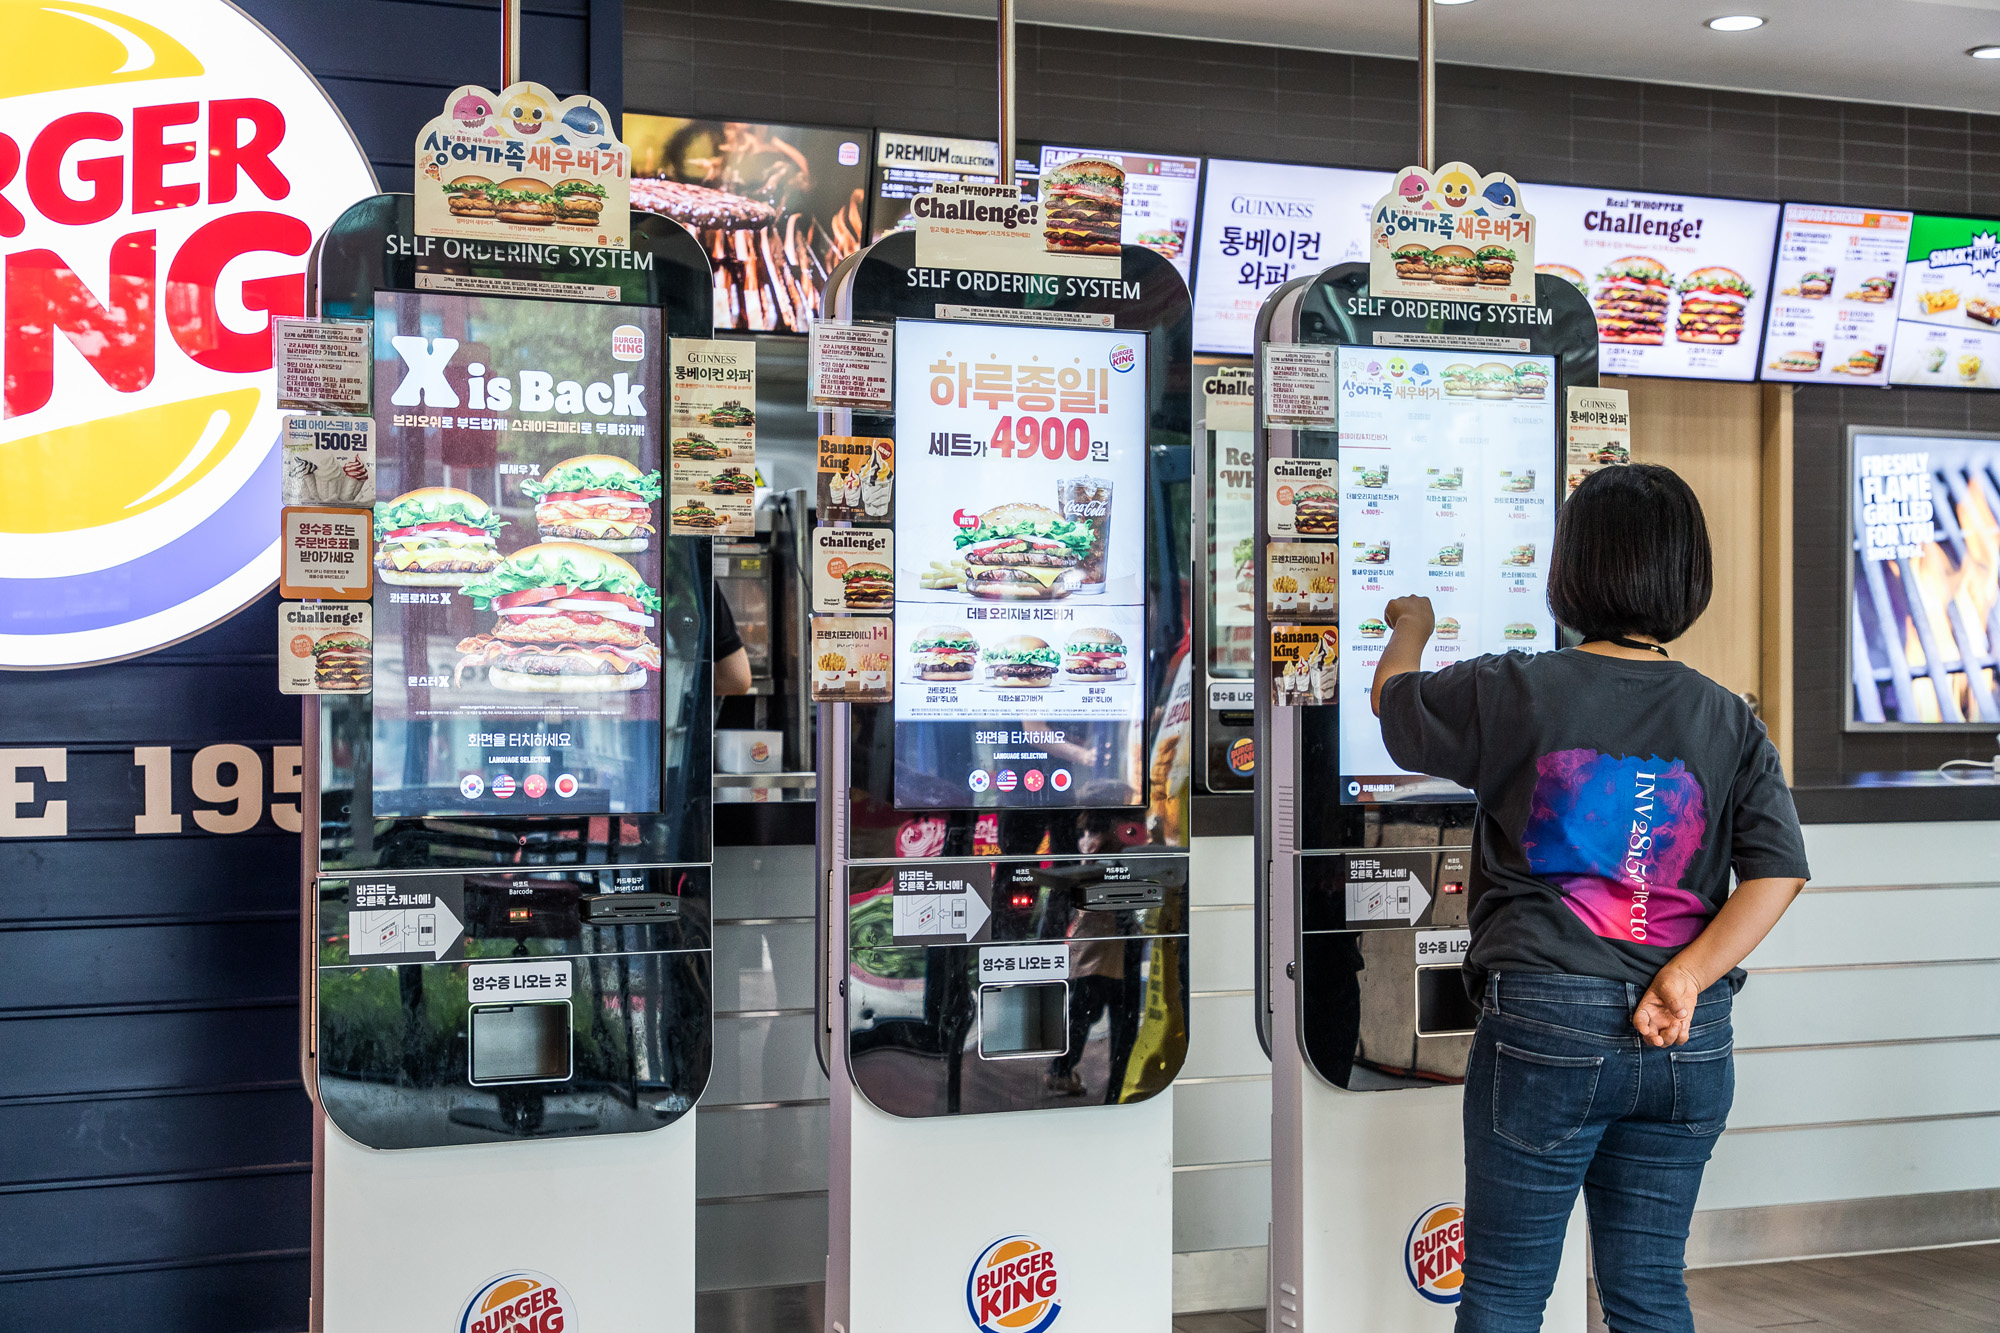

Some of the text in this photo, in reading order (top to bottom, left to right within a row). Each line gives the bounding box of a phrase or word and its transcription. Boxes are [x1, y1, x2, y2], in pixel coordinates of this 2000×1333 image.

[424, 131, 622, 177] 상어가족 새우버거
[886, 143, 994, 166] PREMIUM COLLECTION
[936, 184, 960, 195] Real
[960, 184, 1017, 199] WHOPPER
[1231, 196, 1314, 218] GUINNESS
[1606, 198, 1684, 212] Real WHOPPER
[914, 197, 1039, 229] Challenge!
[1377, 206, 1530, 243] 상어가족 새우버거
[1584, 211, 1703, 242] Challenge!
[1220, 226, 1320, 260] 통베이컨
[386, 233, 436, 257] SELF
[443, 239, 560, 265] ORDERING
[569, 247, 653, 271] SYSTEM
[1238, 262, 1289, 290] 와퍼
[907, 268, 1141, 300] SELF ORDERING SYSTEM
[1348, 298, 1552, 326] SELF ORDERING SYSTEM
[613, 336, 643, 345] BURGER
[613, 344, 643, 354] KING
[1112, 348, 1134, 360] BURGER
[688, 352, 737, 364] GUINNESS
[1112, 354, 1134, 367] KING
[391, 335, 460, 408] X
[467, 362, 512, 411] is
[519, 370, 647, 417] Back
[674, 366, 751, 382] 통베이컨 와퍼
[929, 355, 1109, 414] 하루종일!
[1342, 380, 1440, 400] 상어가족 새우버거
[1580, 399, 1616, 409] GUINNESS
[1570, 410, 1627, 425] 통베이컨 와퍼
[289, 419, 368, 432] 선데 아이스크림 3종
[393, 414, 645, 437] 브리오쉬로 부드럽게! 스테이크패티로 두툼하게!
[314, 432, 367, 451] 1500원
[820, 440, 872, 456] Banana
[928, 432, 987, 458] 세트가
[820, 455, 850, 472] King
[1862, 452, 1929, 476] FRESHLY
[1274, 466, 1332, 479] Challenge!
[1862, 474, 1932, 504] FLAME
[1864, 500, 1933, 526] GRILLED
[959, 516, 976, 526] NEW
[299, 523, 355, 536] 영수증 또는
[1866, 521, 1934, 547] FOR YOU
[295, 536, 359, 550] 주문번호표를
[820, 536, 886, 550] Challenge!
[300, 551, 354, 564] 받아가세요
[1272, 552, 1334, 564] 프렌치프라이(L) 1+1
[287, 612, 363, 626] Challenge!
[966, 608, 1074, 621] 더블 오리지널 치즈버거
[816, 626, 888, 640] 프렌치프라이(L) 1+1
[1274, 632, 1319, 644] Banana
[1274, 646, 1299, 660] King
[1213, 692, 1236, 702] 영수증
[467, 732, 571, 747] 화면을 터치하세요
[976, 731, 1066, 744] 화면을 터치하세요
[489, 756, 551, 764] LANGUAGE SELECTION
[1350, 860, 1380, 870] 바코드는
[899, 871, 933, 880] 바코드는
[1350, 868, 1406, 879] 오른쪽 스캐너에!
[356, 884, 396, 896] 바코드는
[508, 887, 533, 896] Barcode
[614, 884, 644, 892] Insert card
[899, 880, 963, 891] 오른쪽 스캐너에!
[356, 893, 431, 906] 오른쪽 스캐너에!
[1418, 941, 1447, 954] 영수증
[983, 956, 1065, 971] 영수증 나오는 곳
[472, 973, 567, 992] 영수증 나오는 곳
[977, 1252, 1054, 1297] BURGER
[980, 1270, 1056, 1324] KING
[471, 1287, 558, 1333] BURGER
